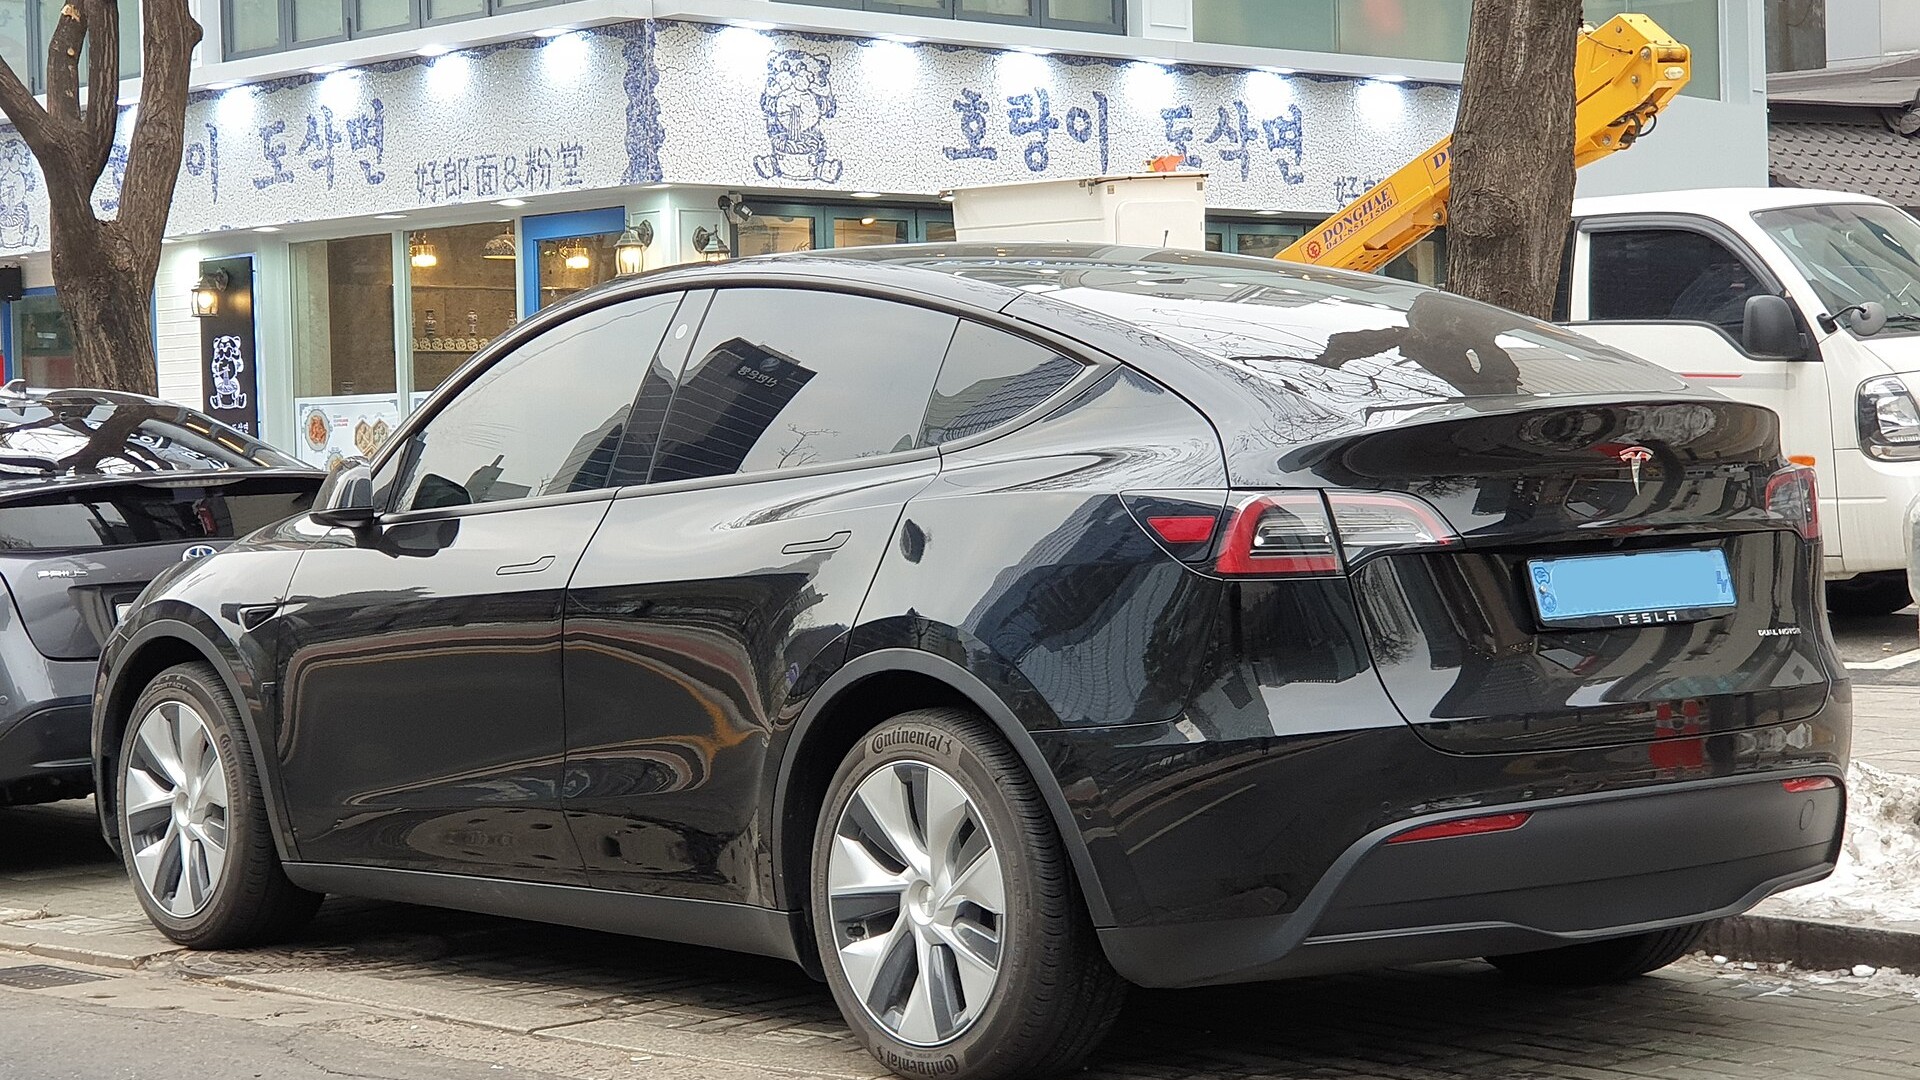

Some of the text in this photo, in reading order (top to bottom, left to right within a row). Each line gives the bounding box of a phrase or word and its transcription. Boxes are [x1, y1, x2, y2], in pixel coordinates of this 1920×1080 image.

[253, 97, 385, 191] 도삭면
[942, 87, 1304, 184] 호랑이 도삭면
[1322, 187, 1391, 244] DONGHAE
[1614, 610, 1678, 625] TESLA
[871, 726, 944, 755] Continental
[886, 1053, 959, 1078] Continental
